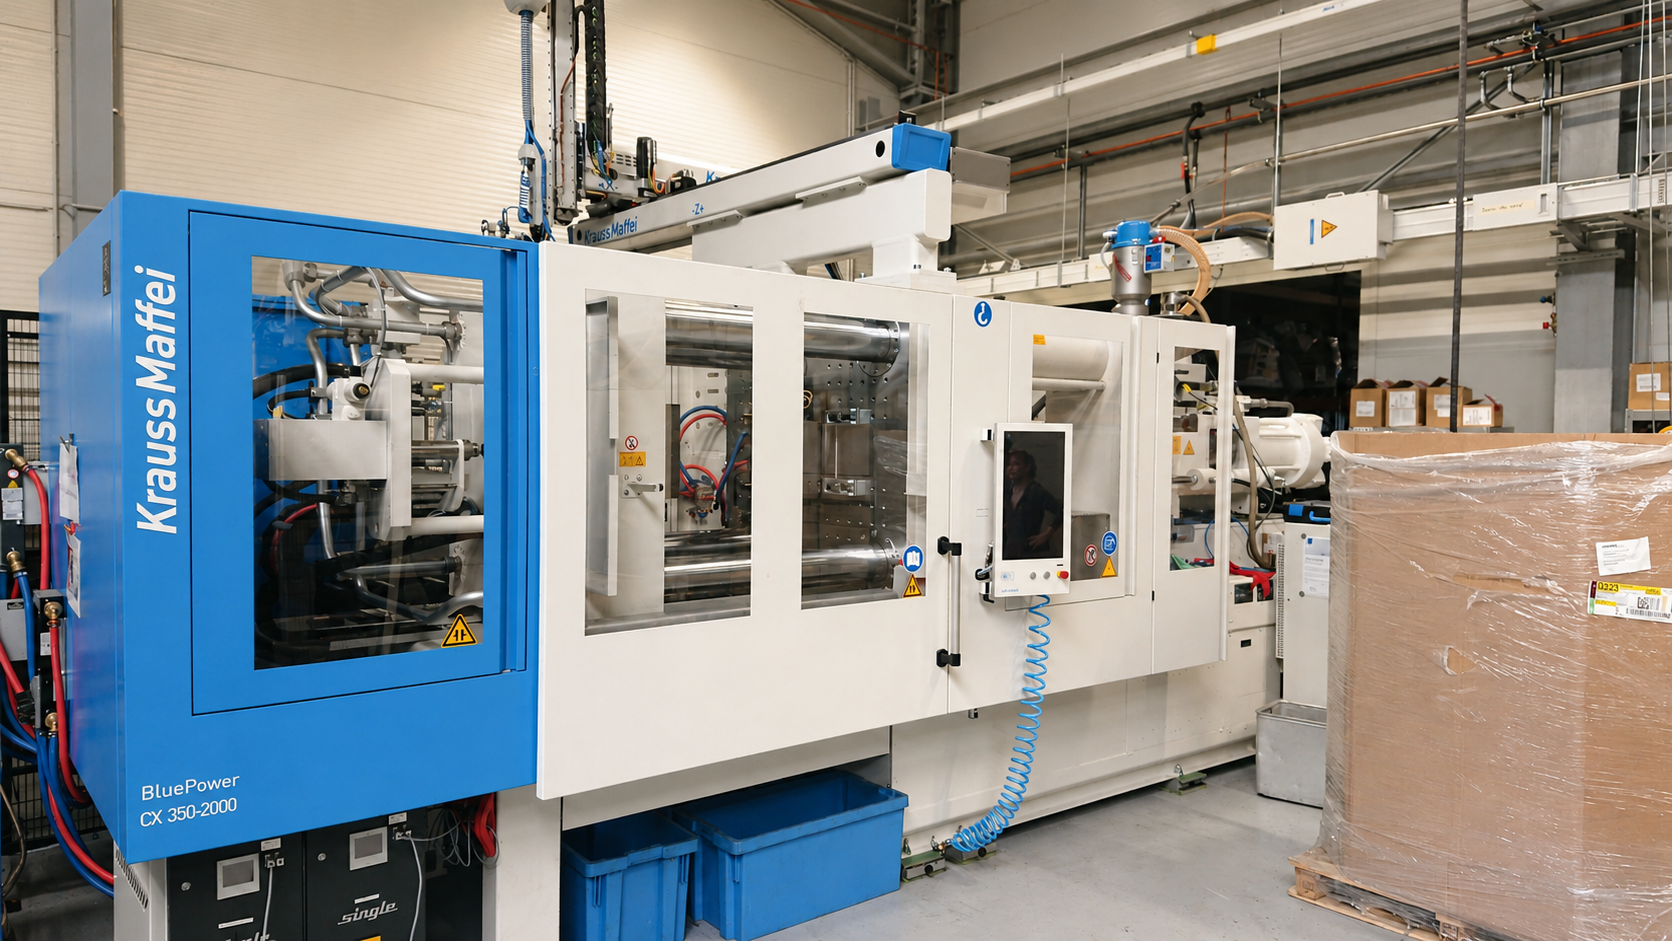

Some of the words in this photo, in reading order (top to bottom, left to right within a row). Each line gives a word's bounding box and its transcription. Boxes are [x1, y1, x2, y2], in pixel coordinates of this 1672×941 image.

[142, 775, 240, 801] BluePower
[140, 809, 162, 827] CX
[167, 797, 237, 823] 350-2000
[337, 900, 398, 926] single
